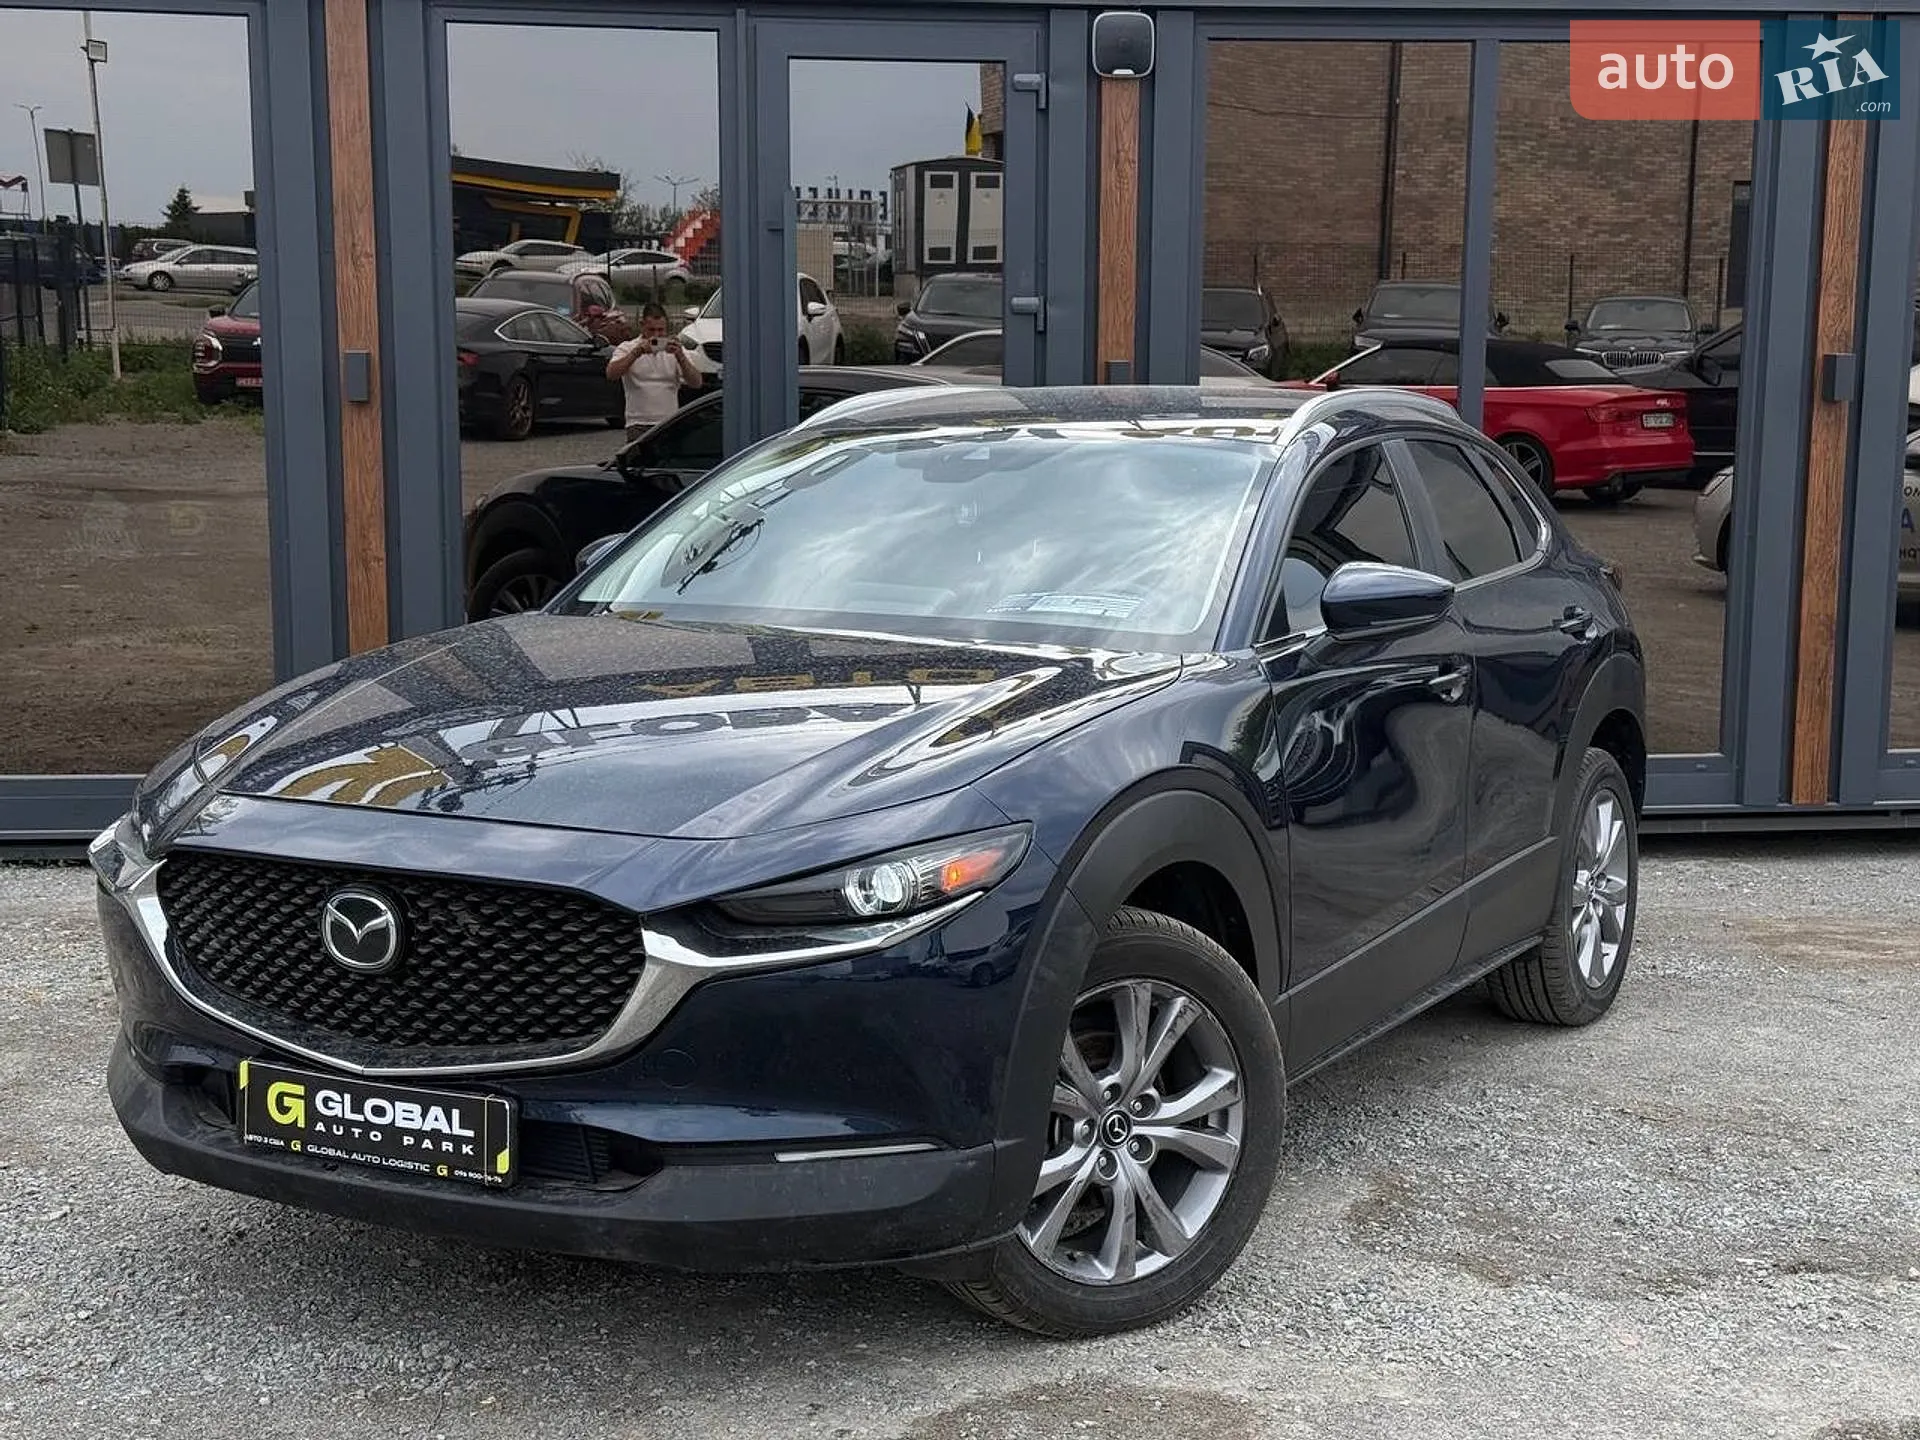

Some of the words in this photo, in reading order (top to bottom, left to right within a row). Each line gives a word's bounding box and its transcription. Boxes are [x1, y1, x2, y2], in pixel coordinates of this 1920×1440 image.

[314, 1089, 475, 1137] GLOBAL
[314, 1121, 383, 1142] AUTO
[402, 1135, 475, 1156] PARK
[307, 1144, 349, 1159] GLOBAL
[350, 1152, 381, 1165] AUTO
[382, 1157, 431, 1173] LOGISTIC
